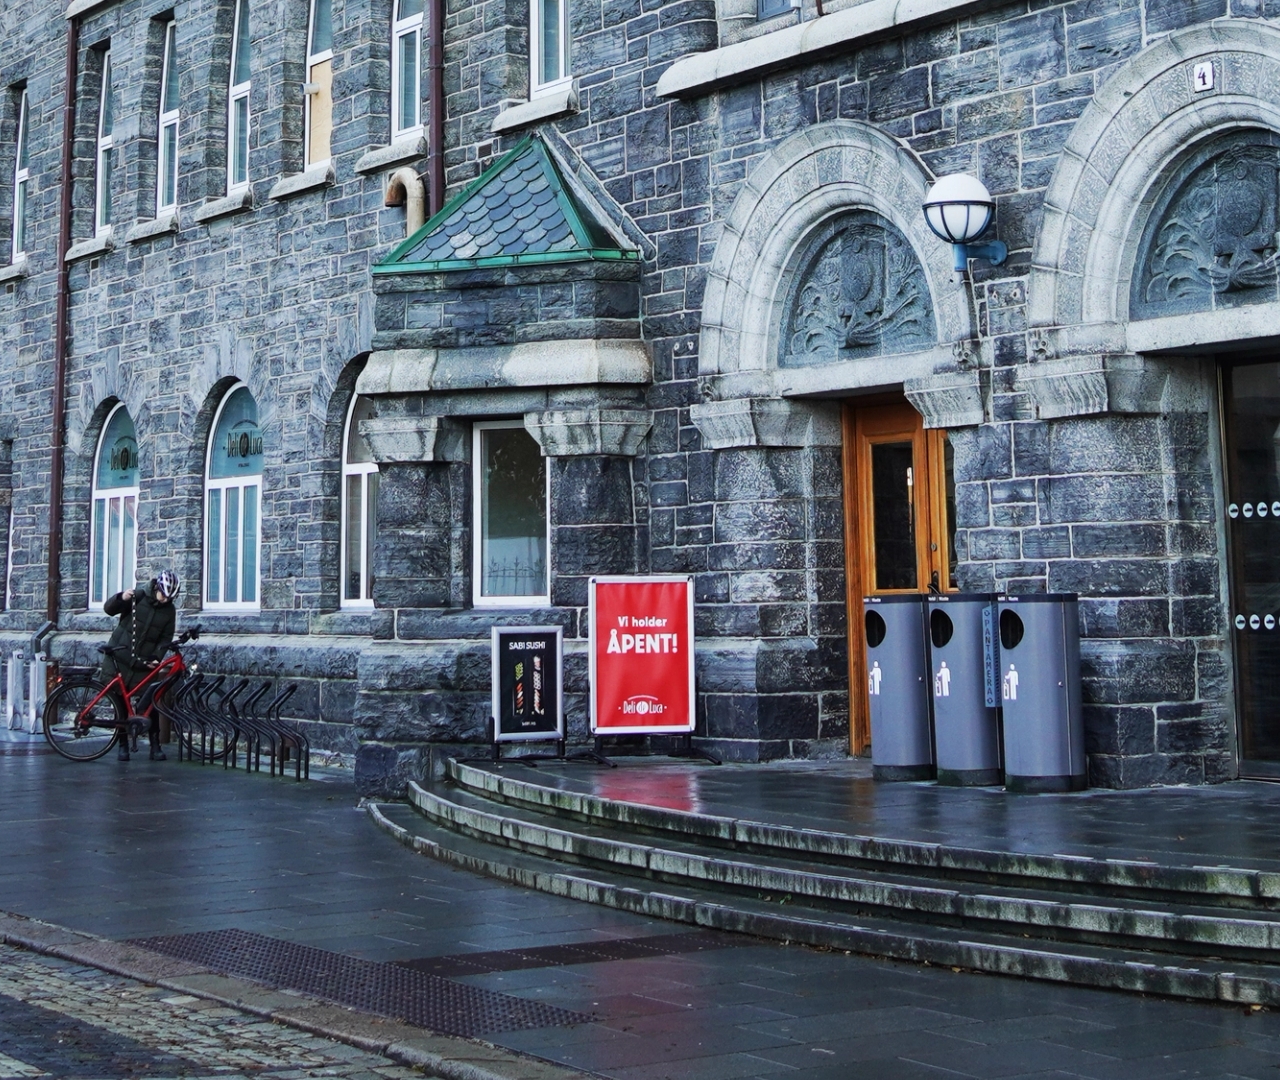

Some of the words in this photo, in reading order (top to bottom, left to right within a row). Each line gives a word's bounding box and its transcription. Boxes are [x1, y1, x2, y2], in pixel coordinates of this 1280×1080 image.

[1198, 67, 1207, 86] 4
[250, 429, 263, 455] Luca
[618, 616, 629, 627] Vi
[632, 616, 668, 627] holder
[509, 641, 525, 650] SABI
[526, 641, 546, 650] SUSHI
[606, 628, 678, 653] ÅPENT!
[984, 620, 993, 695] PANTAMERA
[623, 700, 636, 714] Deli
[649, 700, 663, 714] Luca
